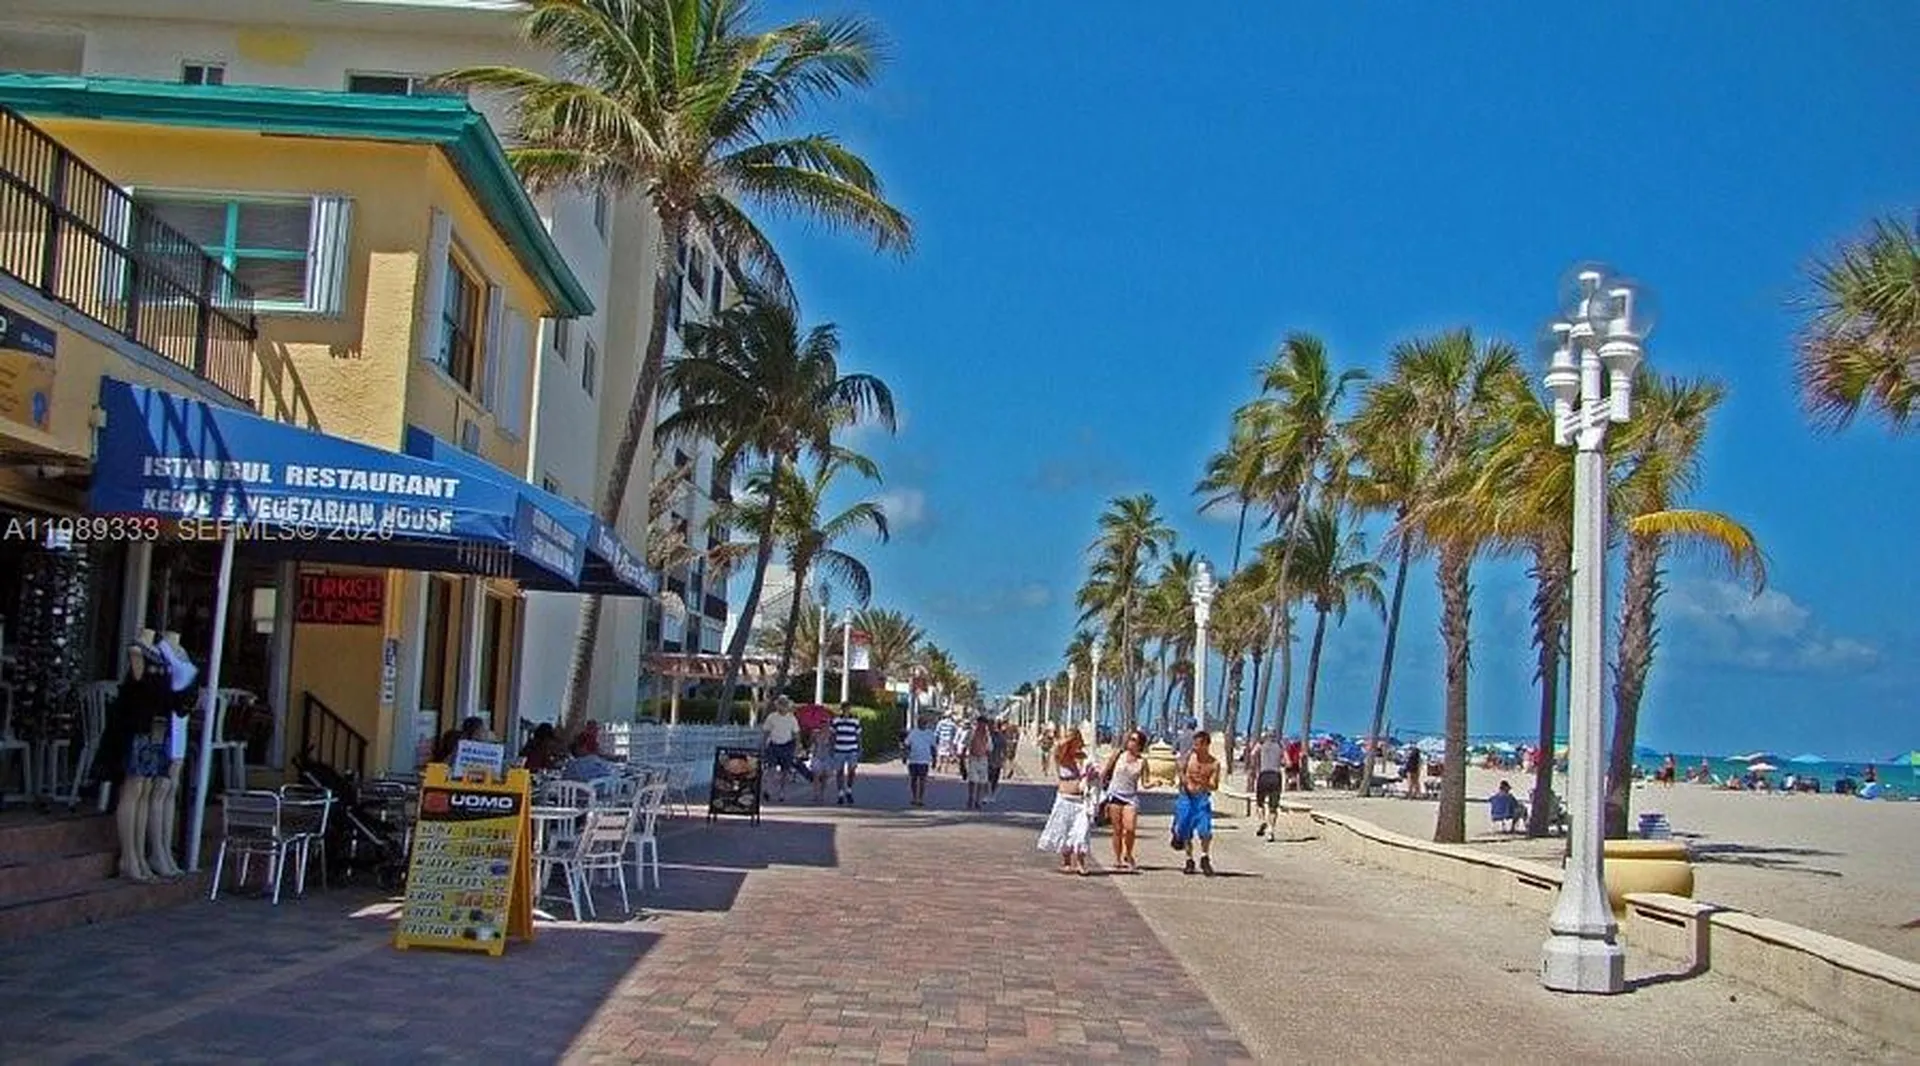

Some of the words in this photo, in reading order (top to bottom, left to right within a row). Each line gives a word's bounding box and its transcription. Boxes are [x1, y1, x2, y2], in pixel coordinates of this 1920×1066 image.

[142, 456, 273, 484] ISTANBUL
[285, 465, 460, 498] RESTAURANT
[246, 494, 375, 527] VEGETARIAN
[382, 503, 454, 534] HOUSE
[302, 576, 381, 599] TURKISH
[299, 599, 379, 621] CUISINE
[451, 793, 513, 809] UOMO
